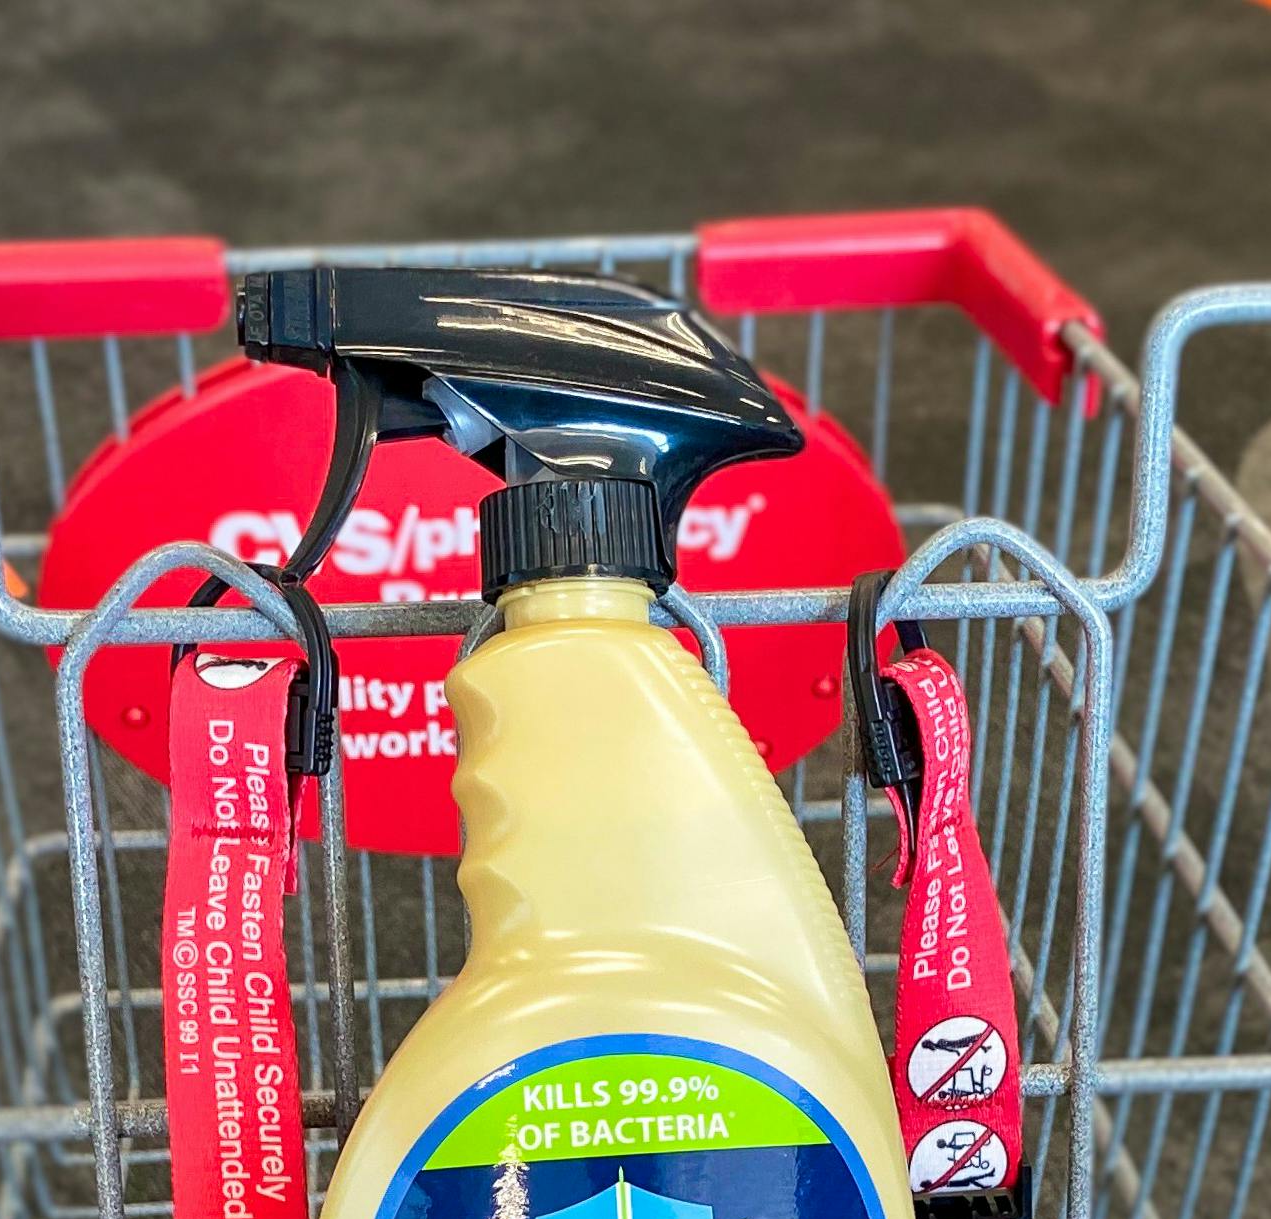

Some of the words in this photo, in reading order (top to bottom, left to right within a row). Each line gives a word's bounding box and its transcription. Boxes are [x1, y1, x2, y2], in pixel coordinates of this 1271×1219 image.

[208, 720, 234, 766] Do
[917, 679, 949, 761] Child
[212, 777, 240, 831] Not
[206, 838, 241, 931] Leave
[242, 853, 270, 961] Fasten
[946, 881, 967, 939] Not
[913, 879, 943, 981] Please
[947, 948, 972, 991] Do
[205, 941, 239, 1025] Child
[244, 972, 280, 1054] Child
[212, 1037, 254, 1219] Unattended
[254, 1064, 292, 1202] Securely
[523, 1080, 611, 1112] KILLS
[618, 1075, 719, 1106] 99.9%
[518, 1123, 560, 1151] OF
